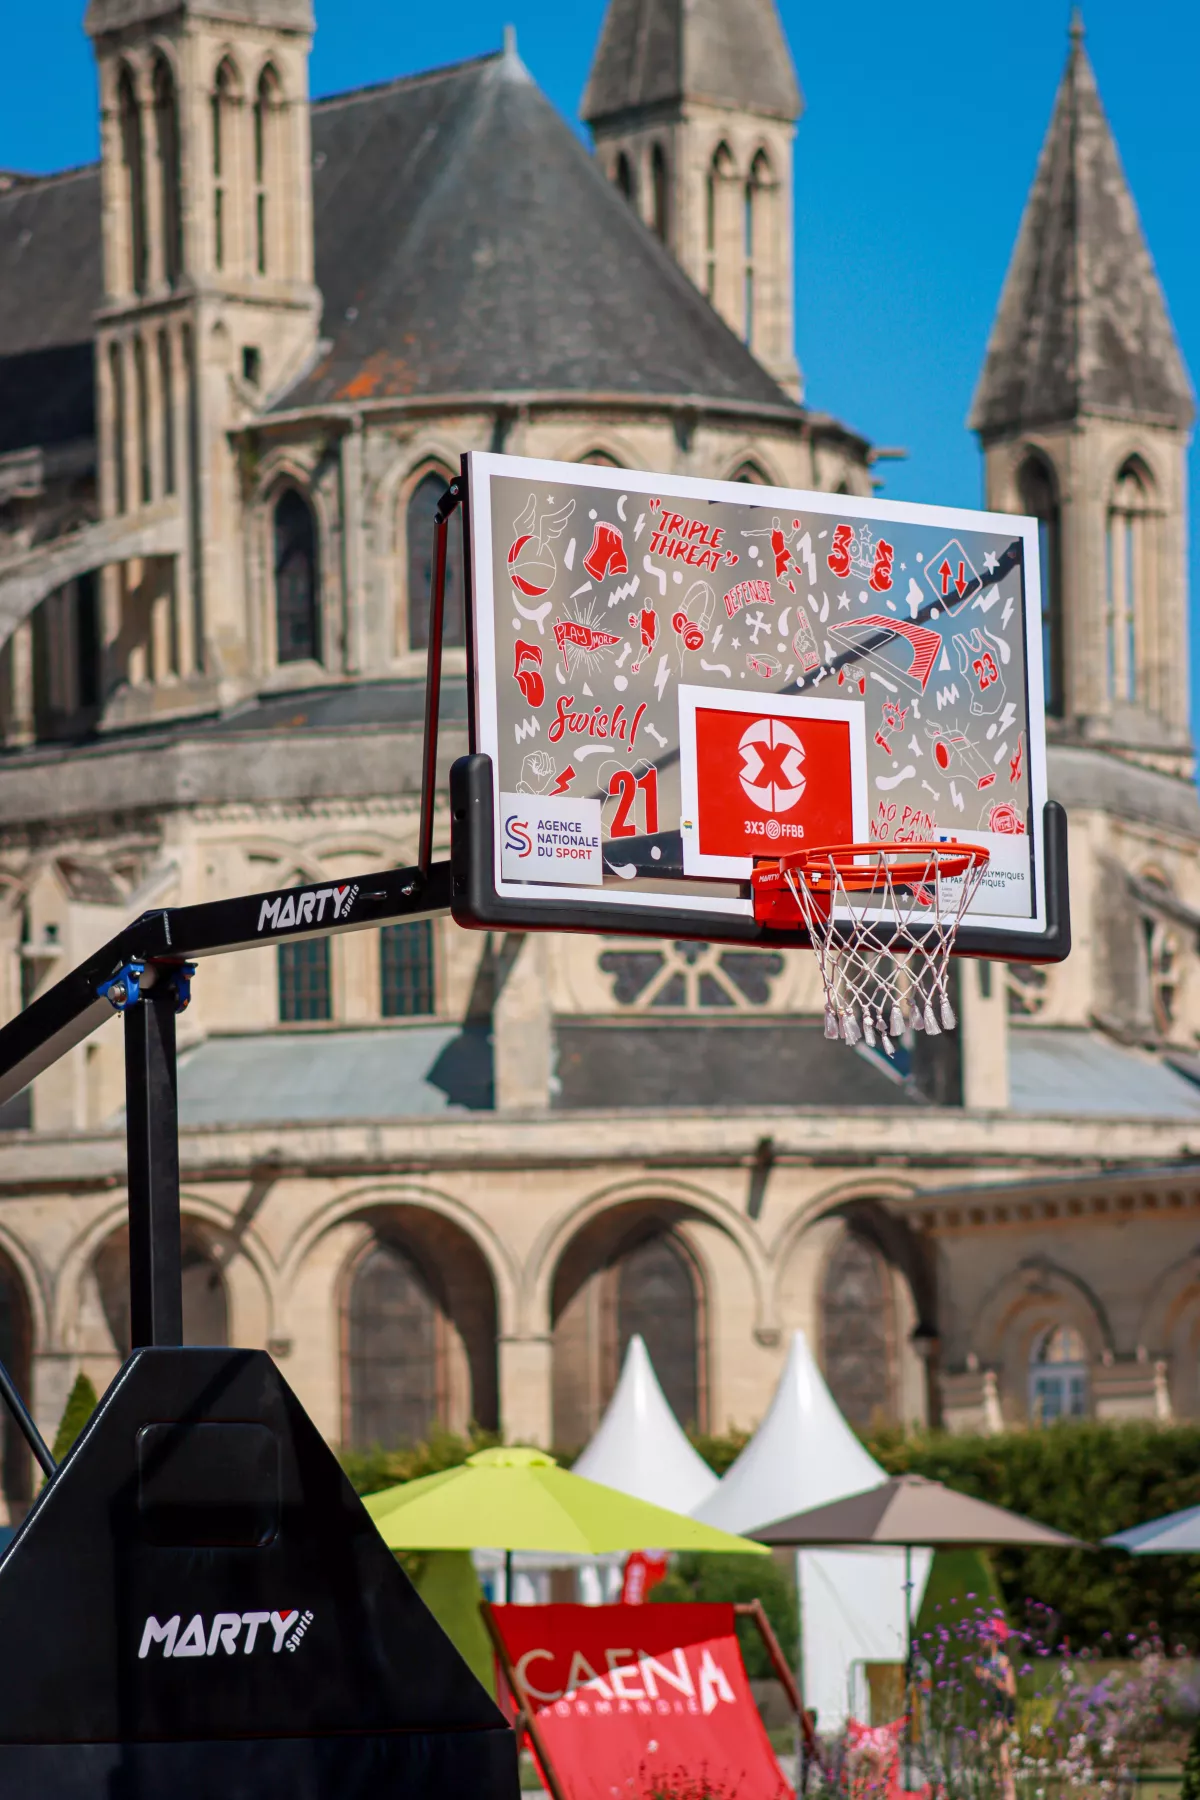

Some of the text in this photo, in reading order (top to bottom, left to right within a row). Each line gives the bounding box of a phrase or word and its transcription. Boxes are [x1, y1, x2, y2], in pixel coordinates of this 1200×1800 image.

[723, 579, 776, 619] DEFENSE
[556, 624, 613, 648] PLAY MORE
[972, 651, 998, 692] 23
[548, 694, 648, 753] Swish!
[607, 769, 659, 839] 21
[877, 799, 938, 831] NO PAIN.
[537, 819, 582, 833] AGENCE
[537, 833, 599, 848] NATIONALE
[781, 823, 805, 839] FFBB
[869, 819, 889, 841] NO
[537, 846, 592, 860] DU SPORT
[257, 885, 351, 932] MARTY
[137, 1609, 300, 1659] MARTY
[514, 1647, 696, 1701] CAEN
